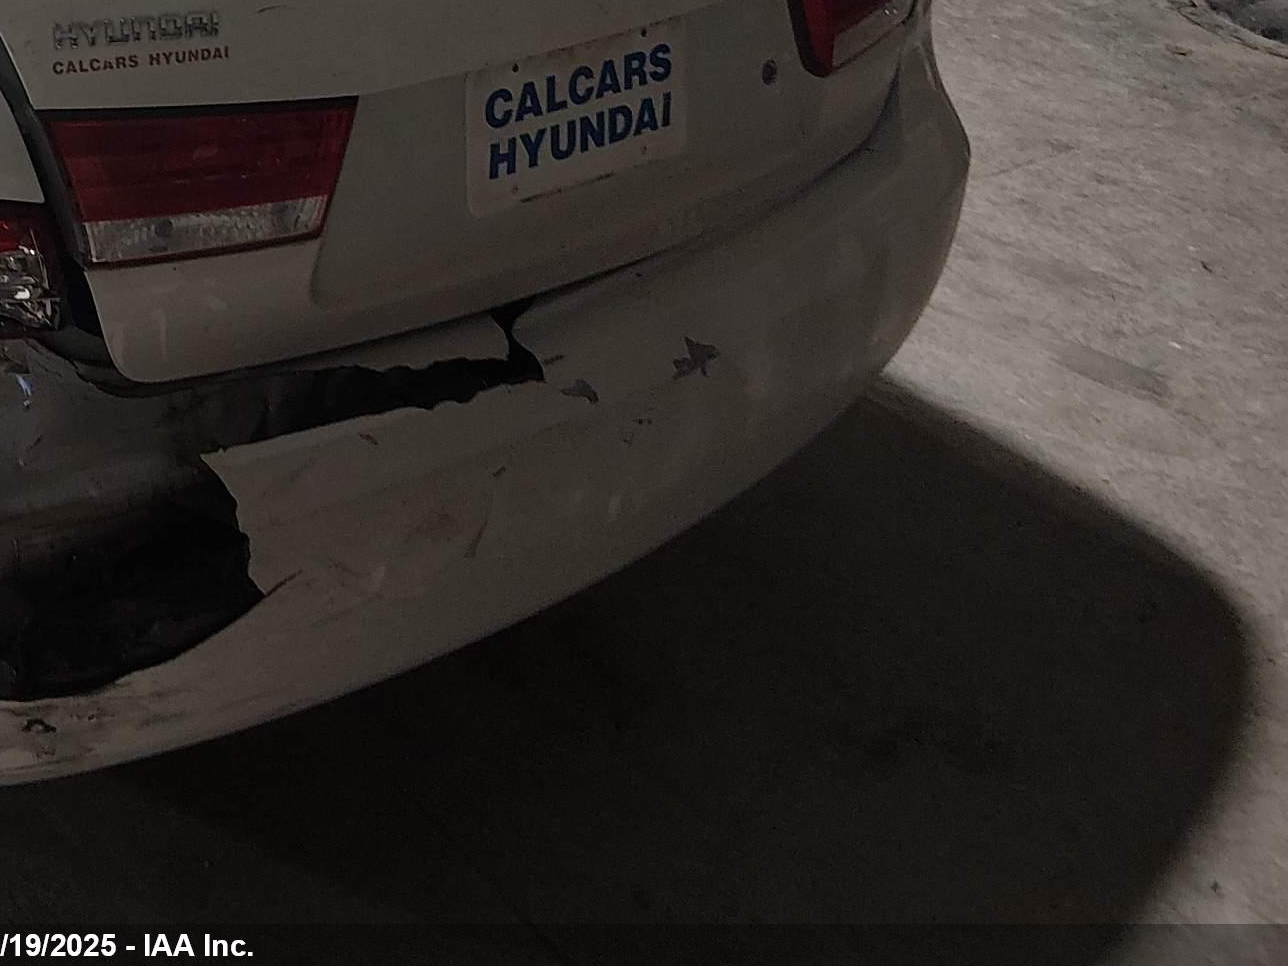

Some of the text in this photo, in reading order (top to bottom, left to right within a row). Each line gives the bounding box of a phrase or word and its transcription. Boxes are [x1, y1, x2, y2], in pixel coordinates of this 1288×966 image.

[52, 46, 230, 75] CALCARS HYUNDAI
[53, 11, 220, 50] HYUNDAI
[484, 43, 673, 129] CALCARS
[489, 91, 672, 180] HYUNDAI
